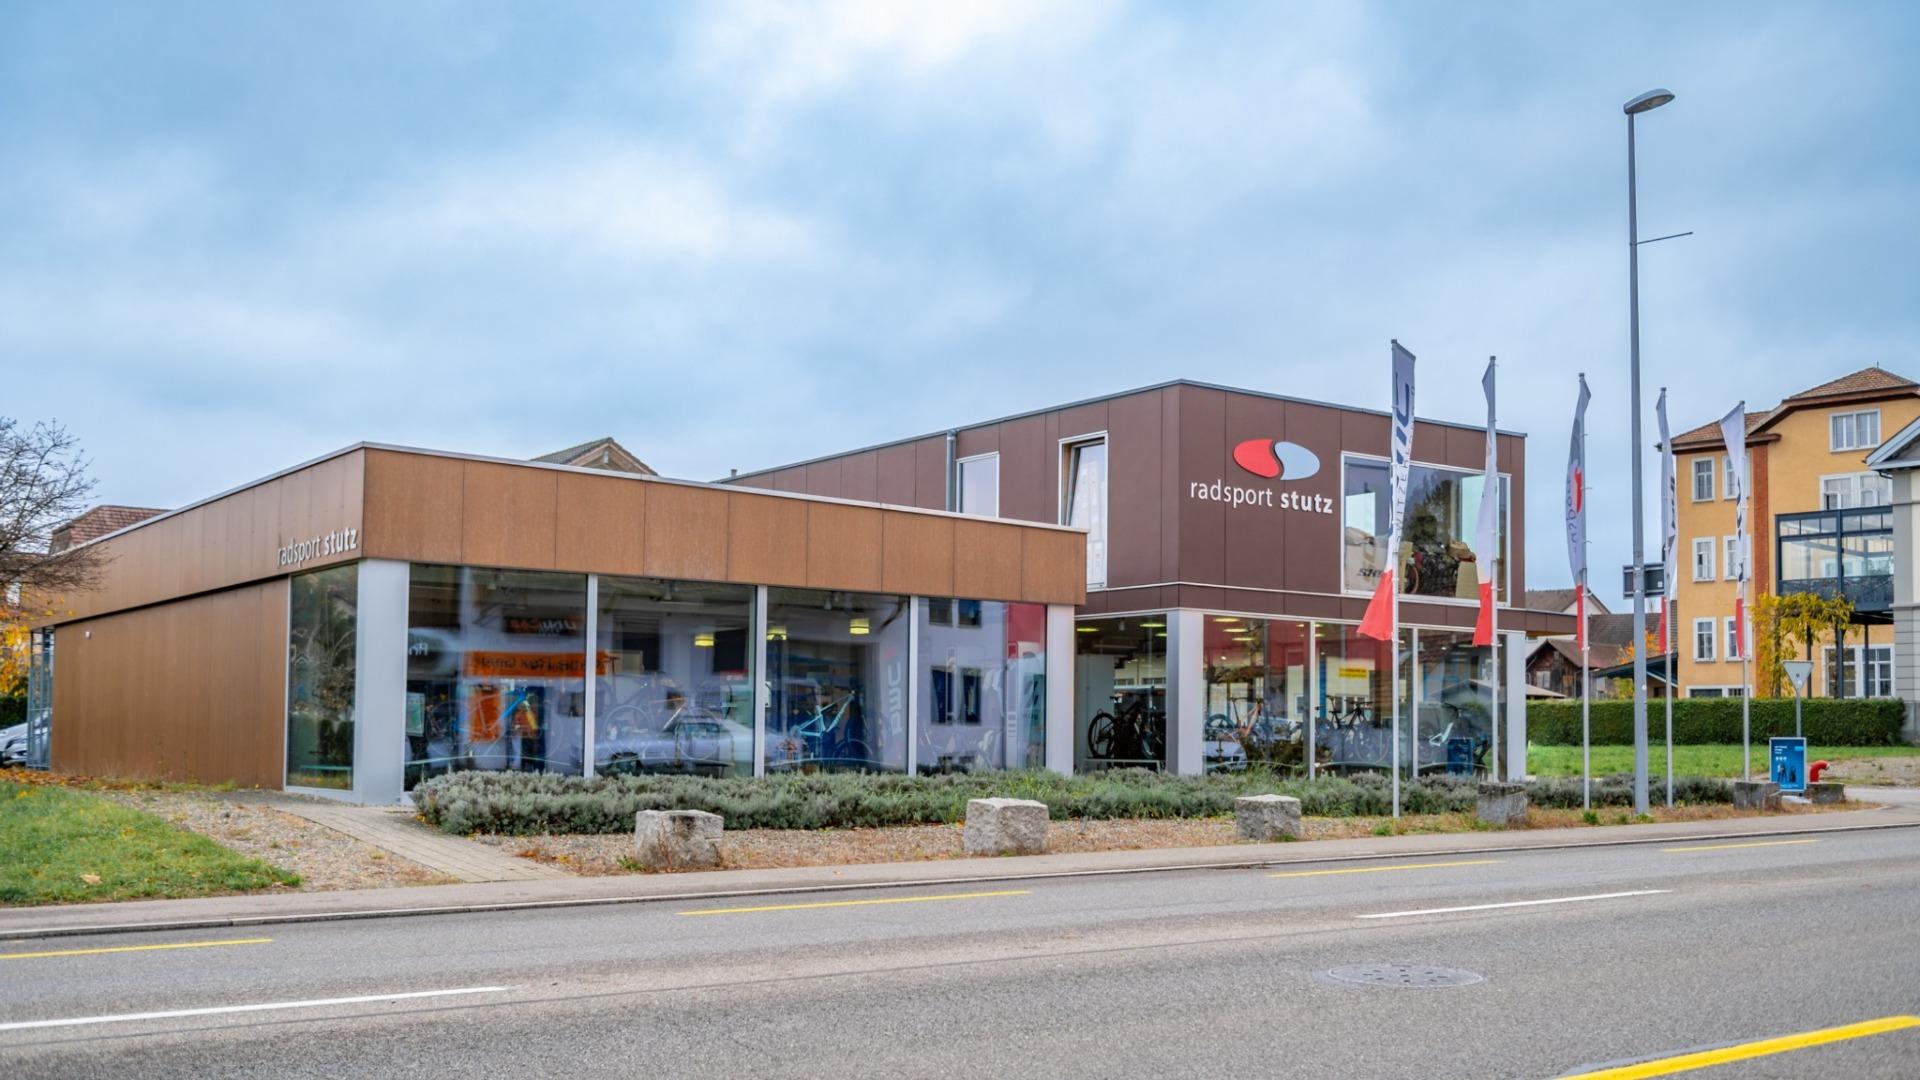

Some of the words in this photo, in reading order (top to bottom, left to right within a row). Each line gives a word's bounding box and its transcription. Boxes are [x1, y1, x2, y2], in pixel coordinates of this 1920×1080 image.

[1190, 479, 1272, 508] radsport
[1280, 491, 1333, 514] stutz
[277, 537, 321, 568] radsport
[324, 527, 357, 555] stutz
